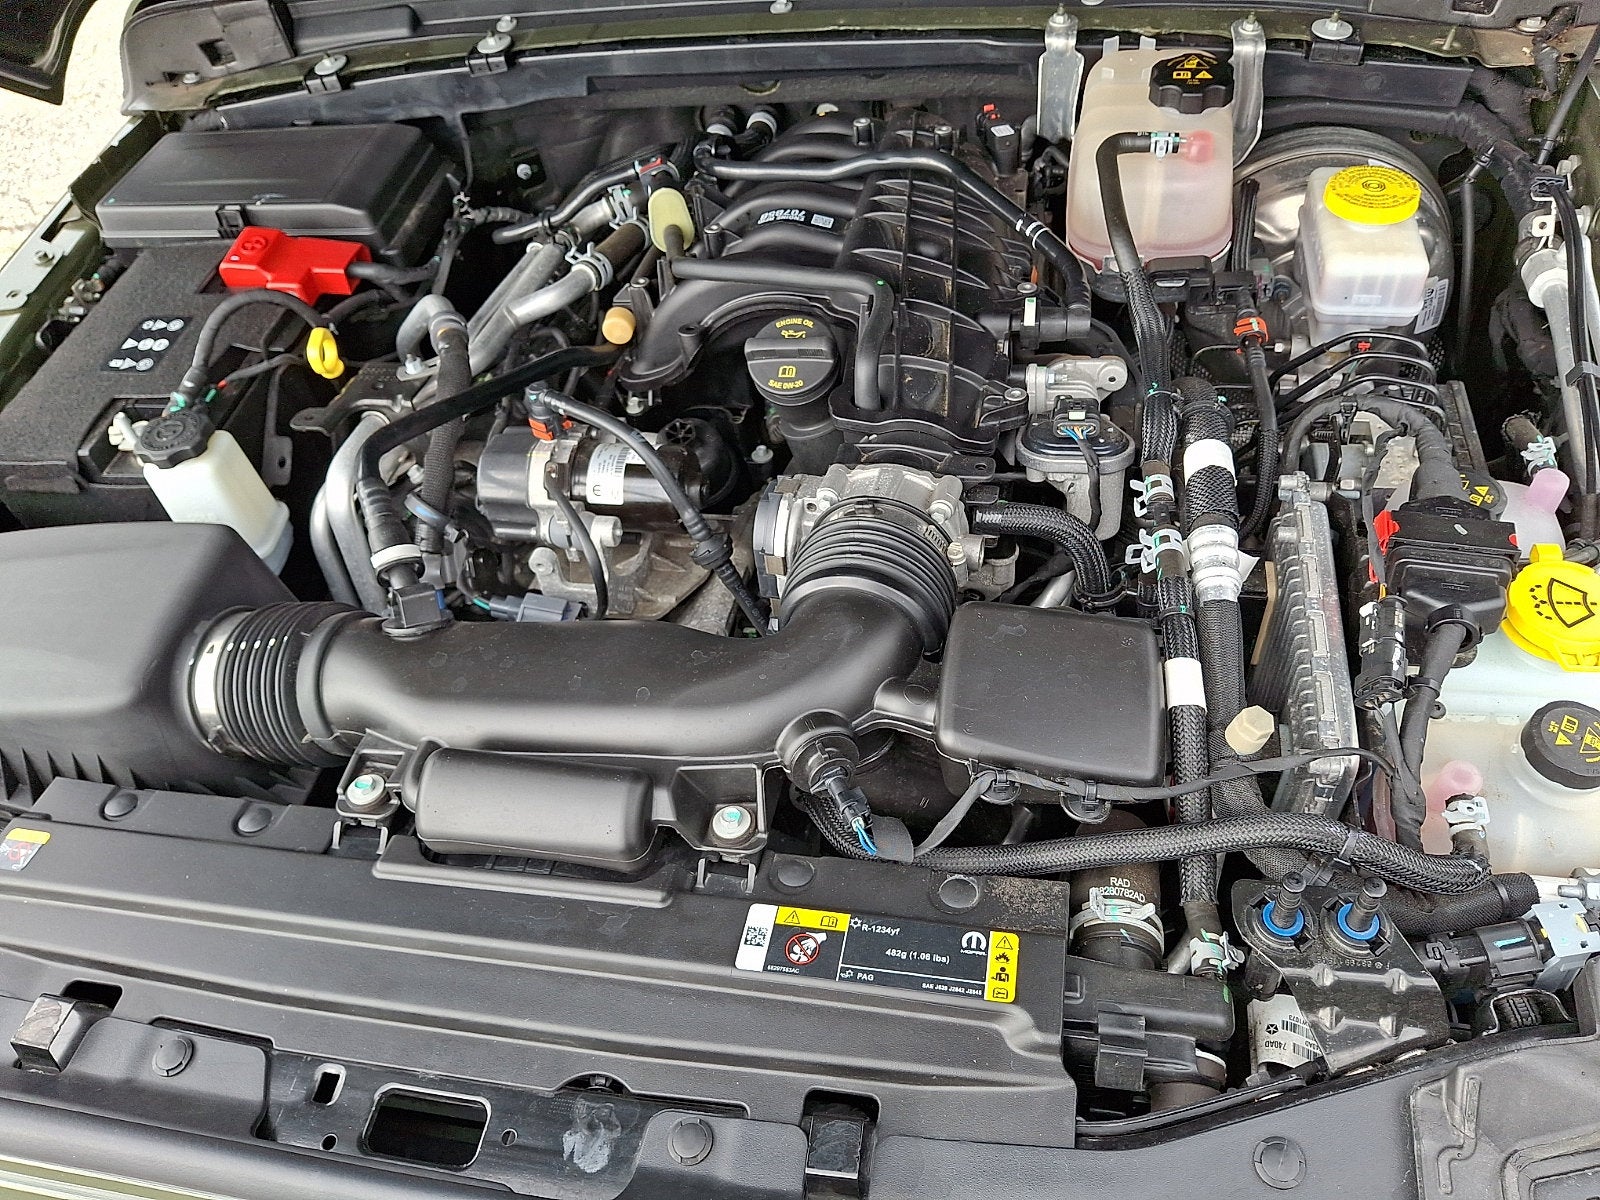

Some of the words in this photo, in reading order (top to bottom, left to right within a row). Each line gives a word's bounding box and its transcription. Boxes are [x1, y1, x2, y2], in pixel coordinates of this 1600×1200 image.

[776, 318, 803, 328] ENGINE
[803, 319, 814, 328] OIL
[768, 380, 782, 389] SAE
[783, 380, 803, 389] 0W-20
[1109, 876, 1131, 888] RAD
[861, 924, 900, 936] R-1234yf
[885, 949, 907, 959] 482g
[933, 954, 950, 964] lbs)
[856, 973, 874, 981] PAG
[1264, 1041, 1287, 1050] 740AD
